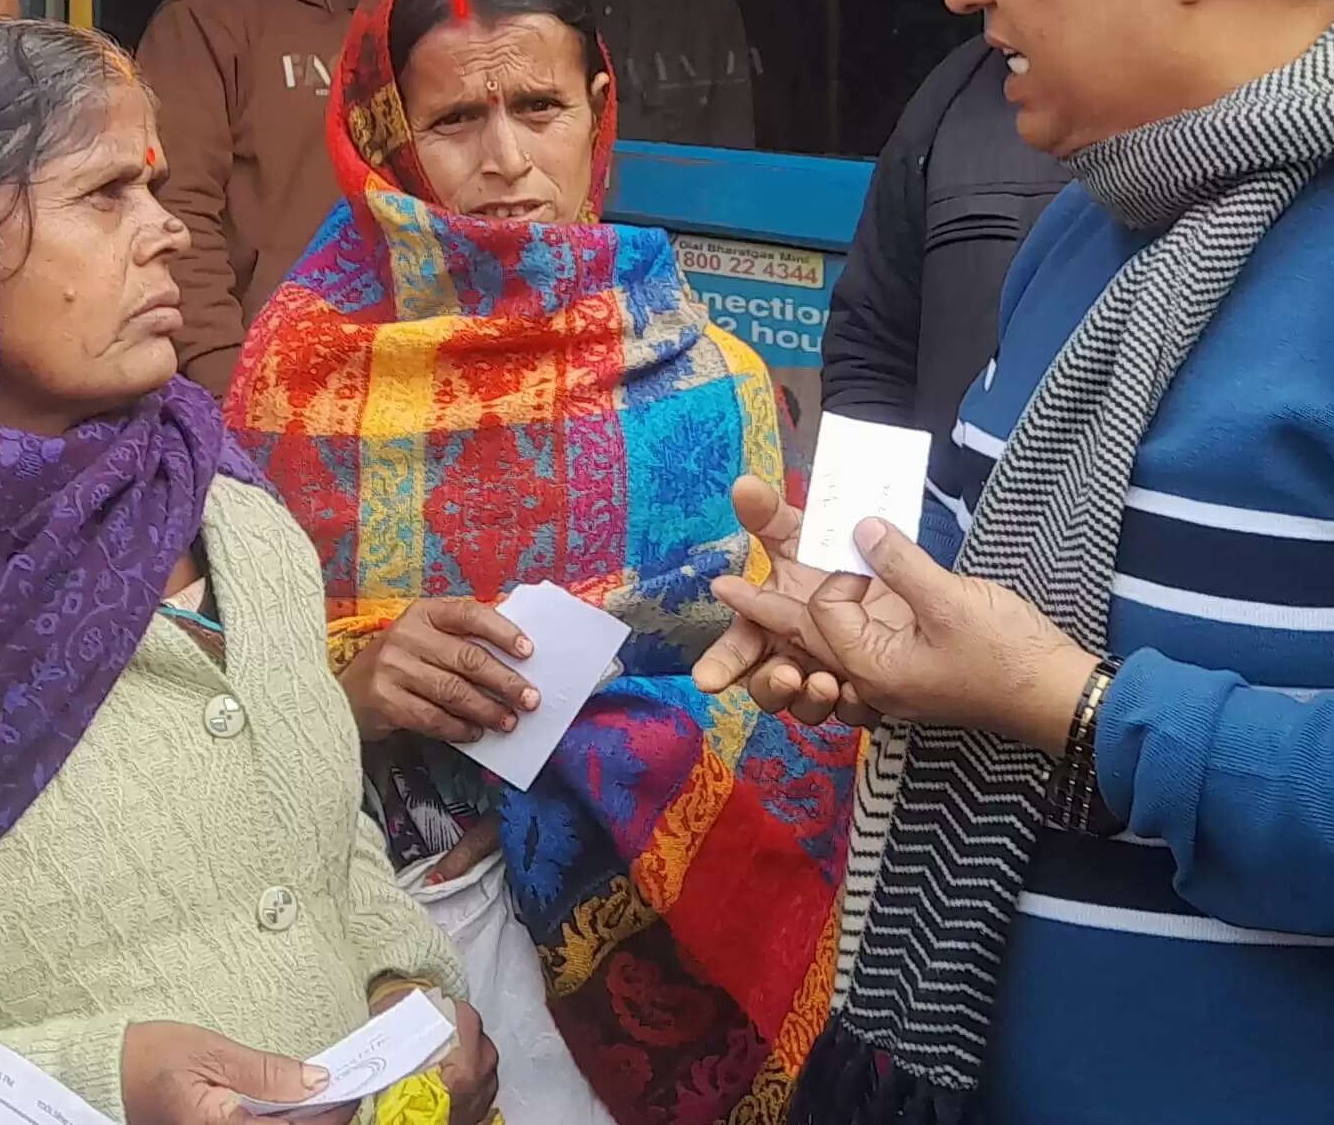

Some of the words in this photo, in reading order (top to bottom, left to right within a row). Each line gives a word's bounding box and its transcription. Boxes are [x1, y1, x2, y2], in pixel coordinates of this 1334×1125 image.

[729, 256, 756, 276] 22
[762, 261, 819, 285] 4344
[751, 320, 823, 353] hou
